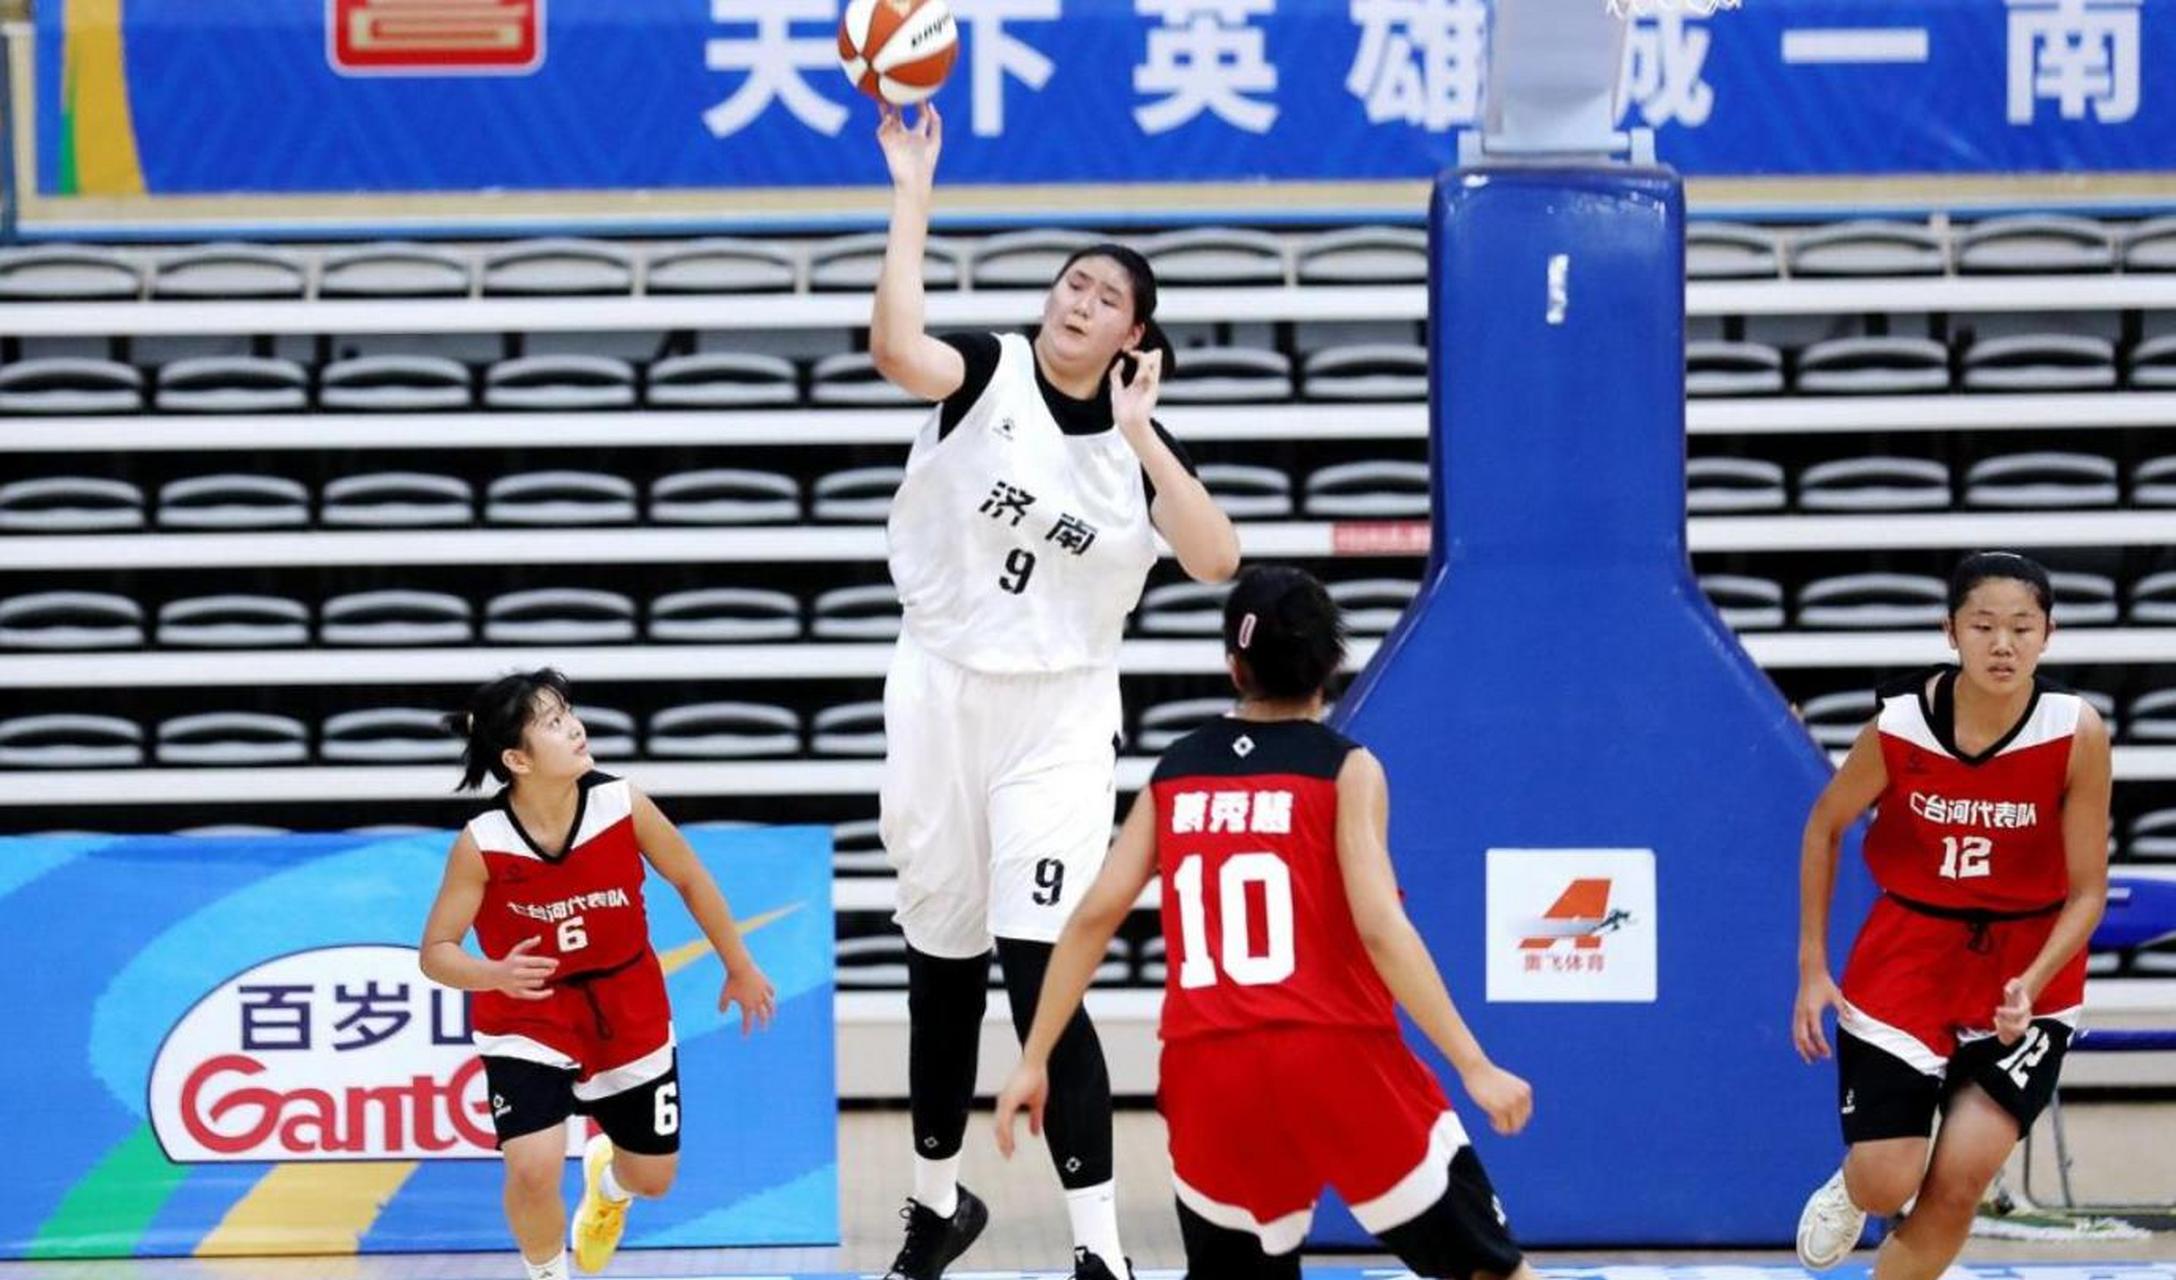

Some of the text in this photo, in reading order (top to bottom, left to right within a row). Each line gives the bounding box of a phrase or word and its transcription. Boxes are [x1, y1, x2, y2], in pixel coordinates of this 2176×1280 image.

[978, 480, 1099, 556] 济南
[999, 548, 1037, 595] 9
[1032, 858, 1064, 906] 9
[1938, 835, 1993, 880] 12
[556, 916, 588, 953] 6
[1173, 851, 1296, 989] 10
[1996, 1026, 2051, 1090] 12
[654, 1081, 679, 1136] 6
